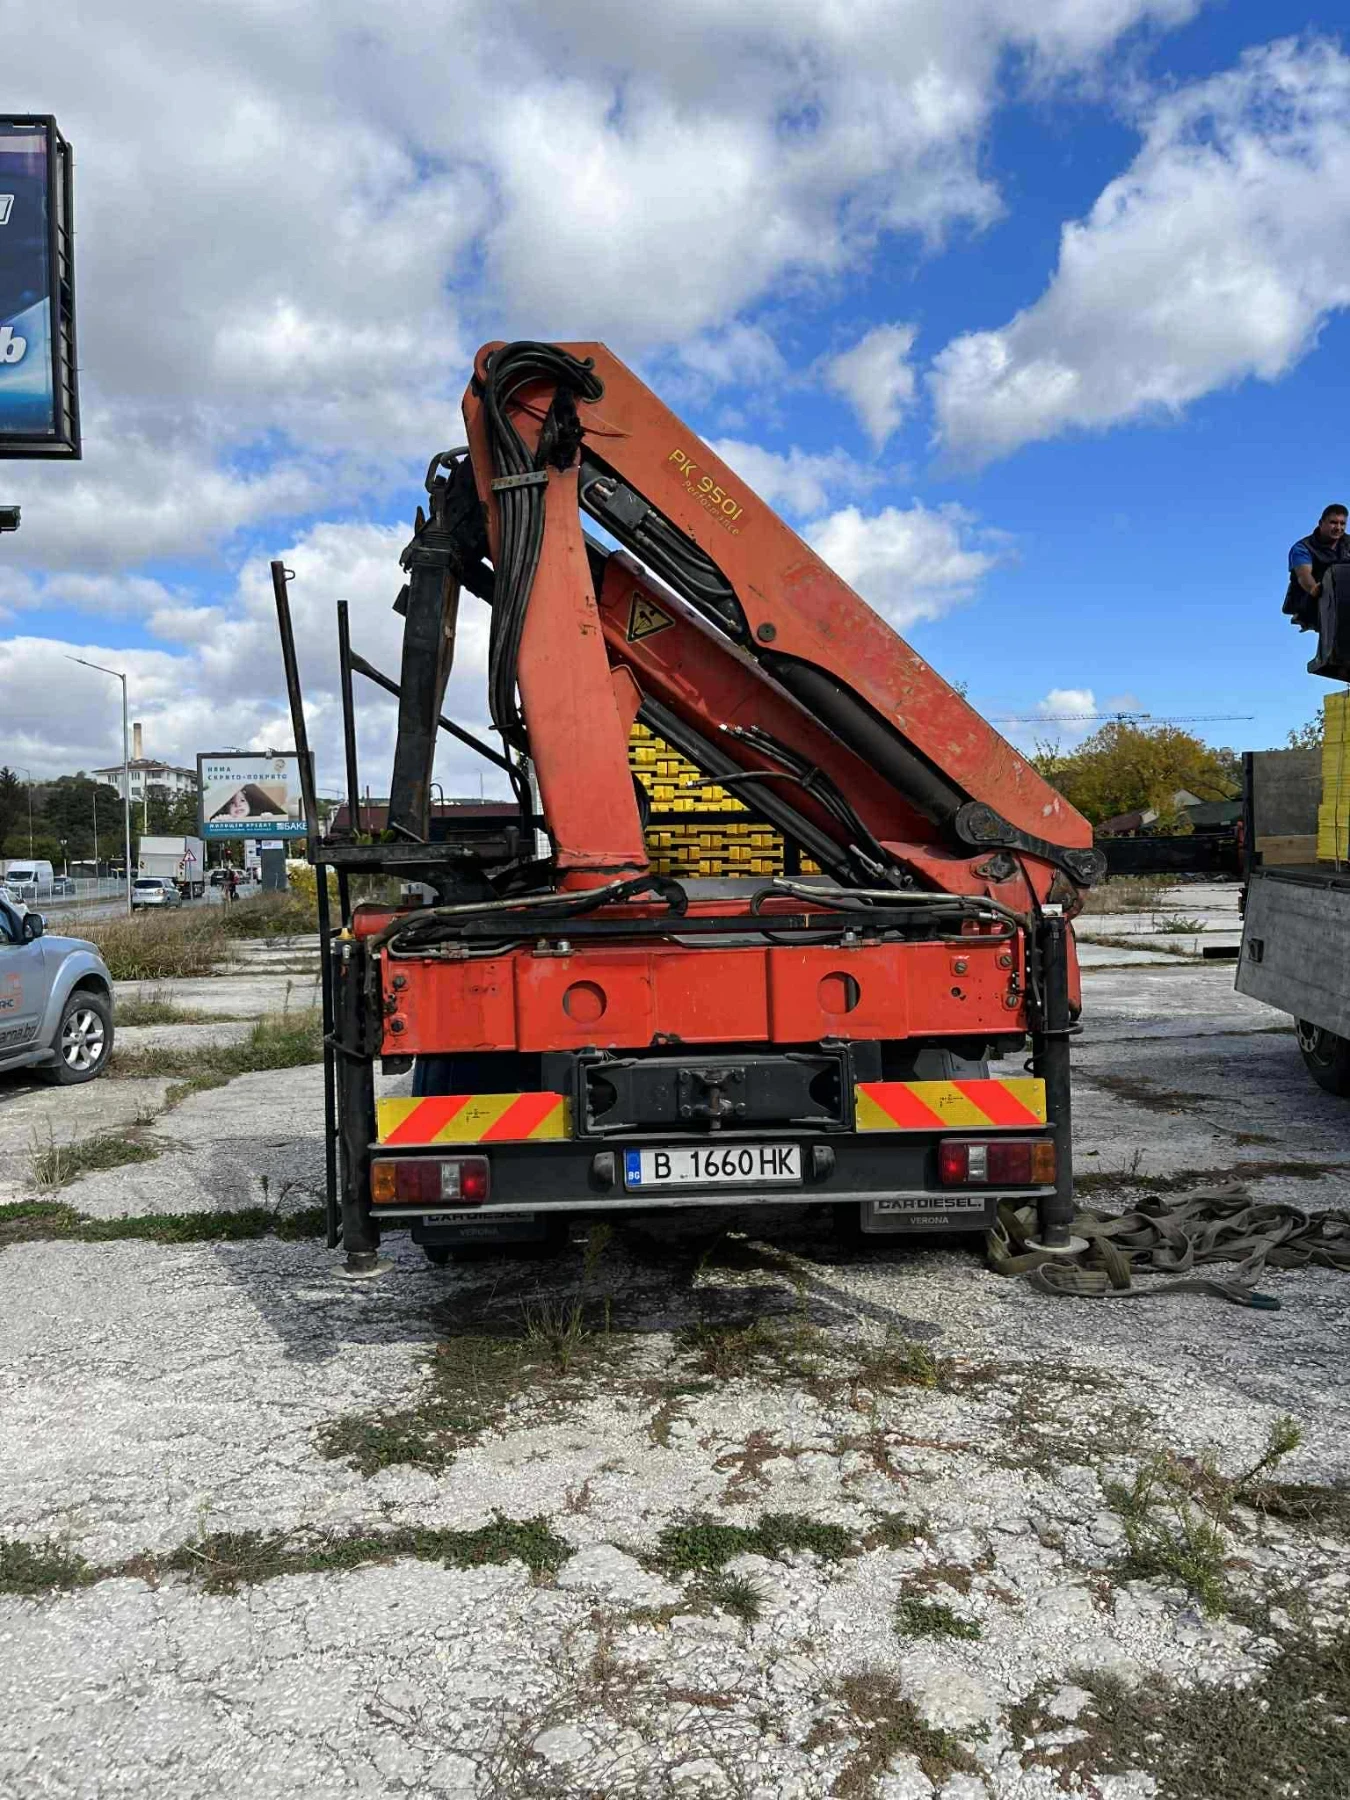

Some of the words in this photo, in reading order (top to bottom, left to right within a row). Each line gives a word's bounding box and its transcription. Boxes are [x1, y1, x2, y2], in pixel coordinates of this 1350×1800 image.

[668, 449, 697, 478] PK
[654, 1152, 672, 1179] B
[690, 1149, 754, 1178] 1660
[759, 1148, 795, 1176] HK
[628, 1171, 640, 1180] BG
[910, 1216, 949, 1225] VERONA
